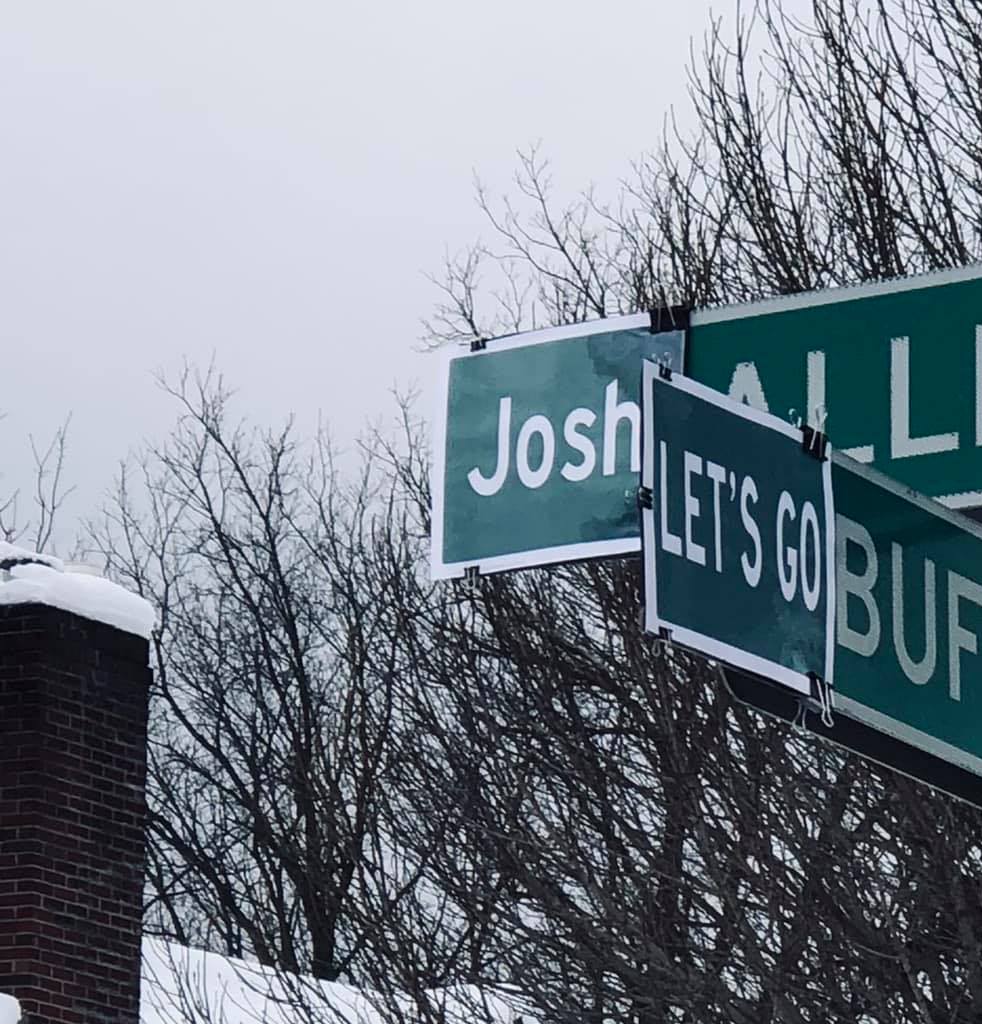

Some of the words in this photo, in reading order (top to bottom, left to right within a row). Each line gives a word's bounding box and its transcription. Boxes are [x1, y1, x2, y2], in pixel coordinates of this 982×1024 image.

[467, 379, 642, 497] Josh
[659, 440, 763, 588] LET'S
[776, 490, 821, 612] GO
